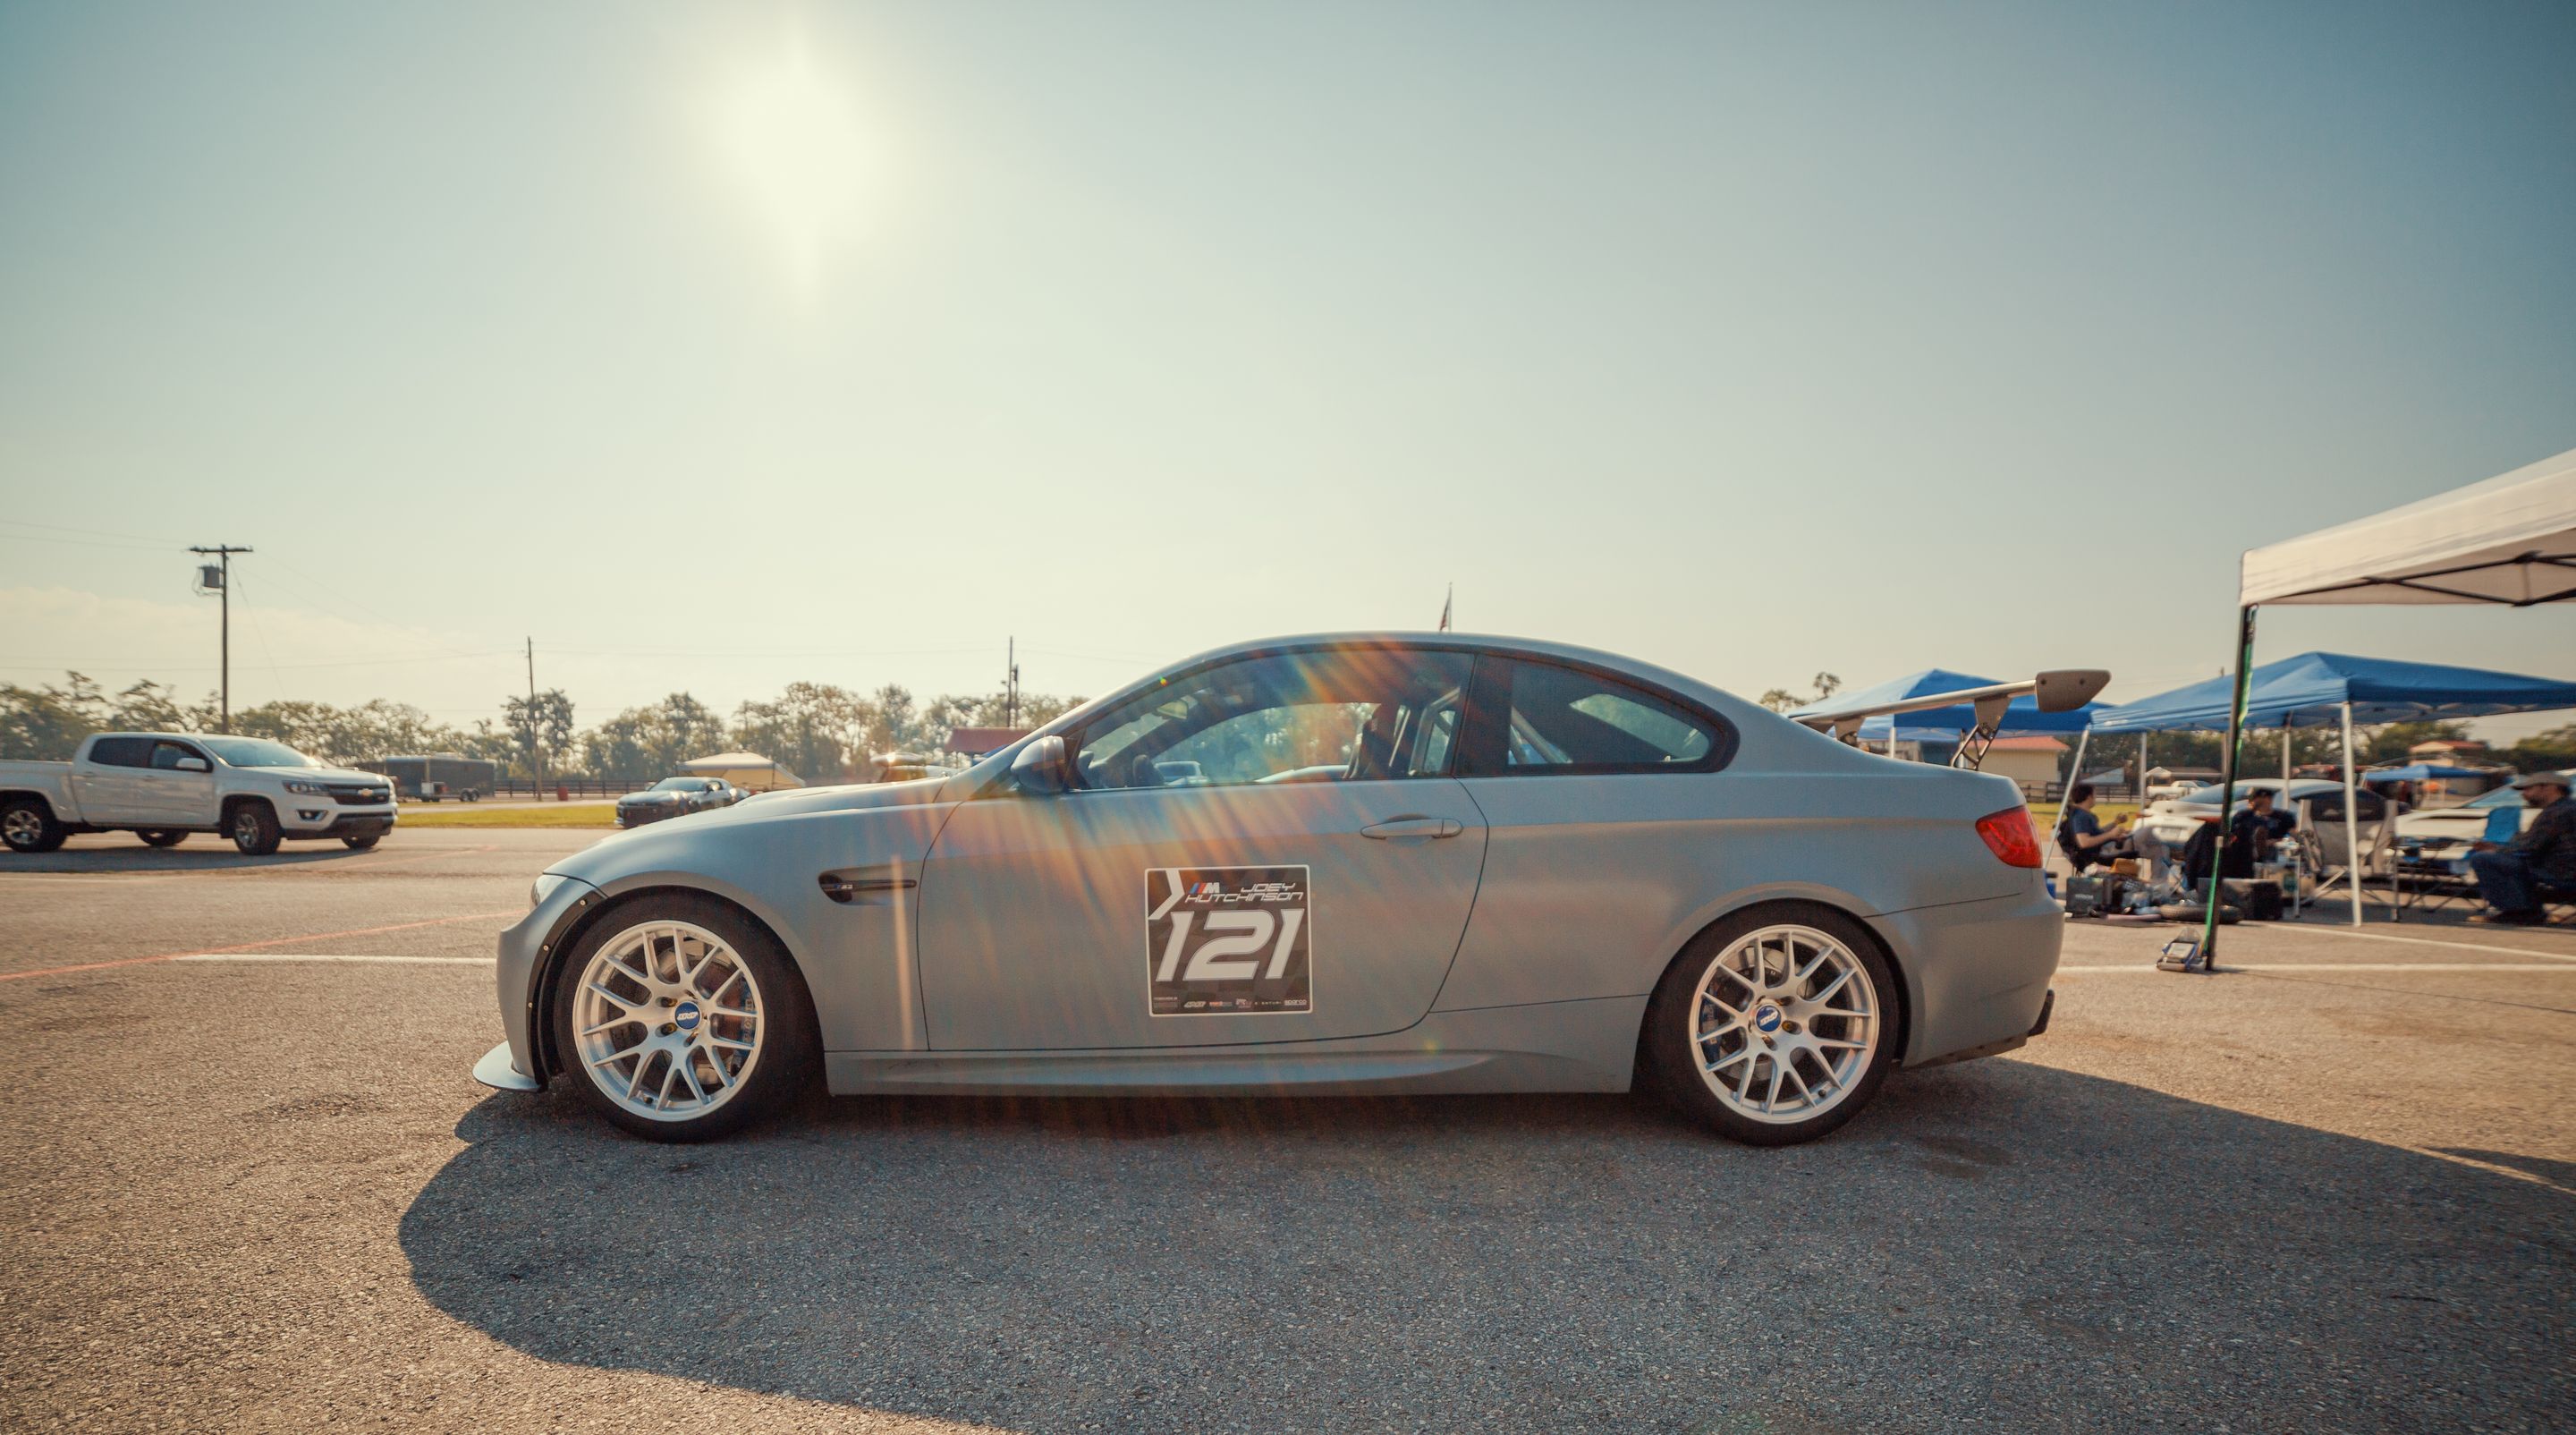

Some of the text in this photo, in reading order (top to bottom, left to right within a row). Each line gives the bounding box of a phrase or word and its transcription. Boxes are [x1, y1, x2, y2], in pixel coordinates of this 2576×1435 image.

[1241, 883, 1296, 893] JOEY
[1184, 892, 1304, 904] HUTCHINSON
[1155, 908, 1306, 982] 121
